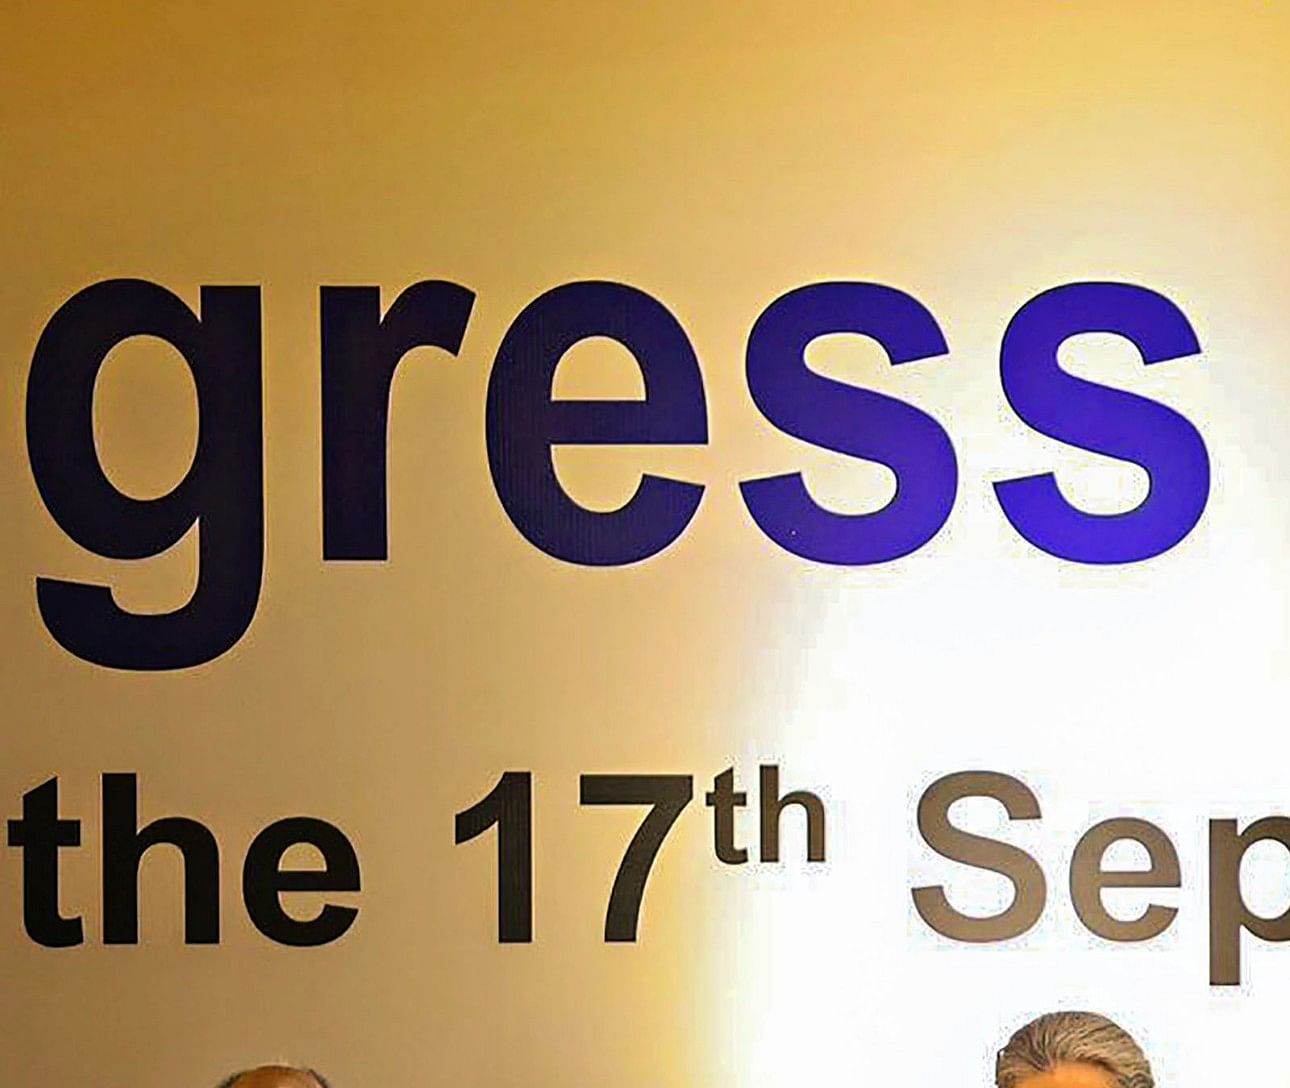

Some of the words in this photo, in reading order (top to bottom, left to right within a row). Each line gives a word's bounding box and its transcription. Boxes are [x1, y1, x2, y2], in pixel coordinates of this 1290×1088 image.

[24, 277, 1212, 671] gress
[6, 771, 362, 948] the
[455, 764, 828, 944] 17th
